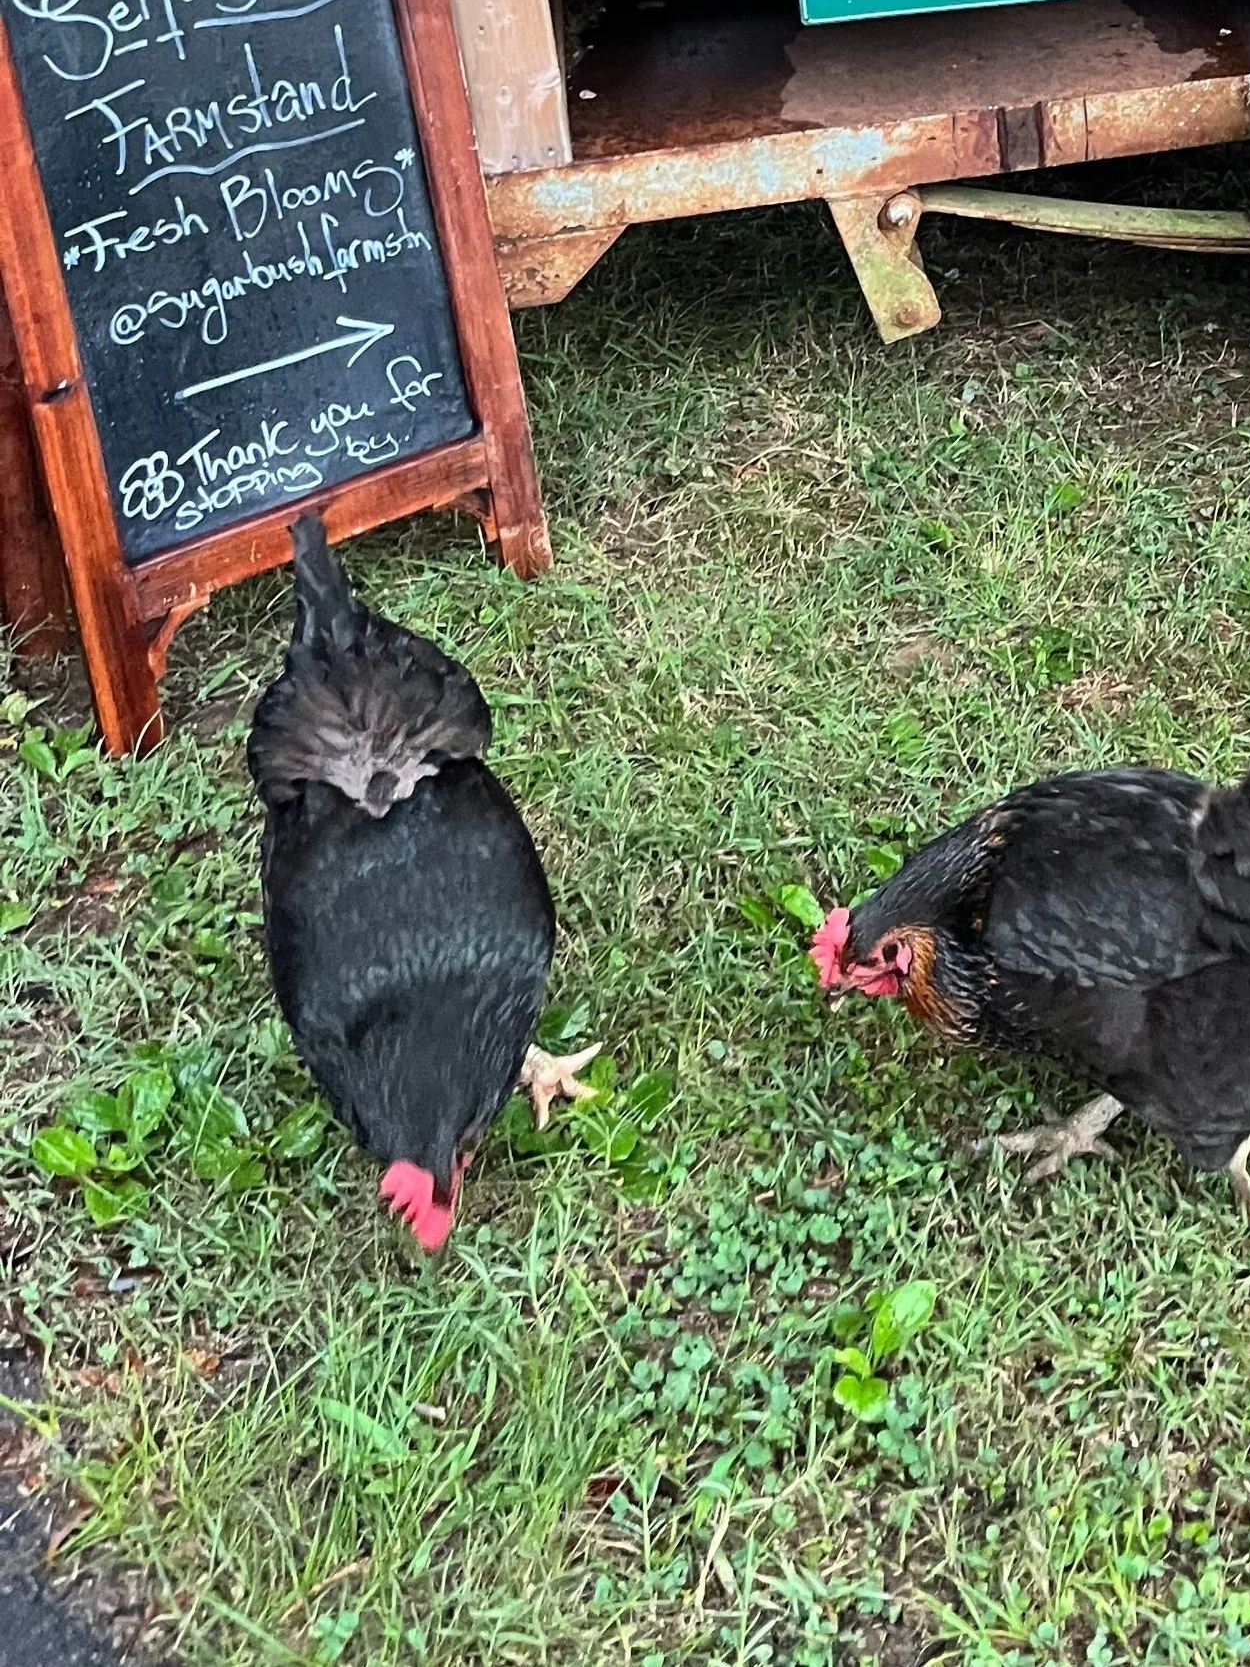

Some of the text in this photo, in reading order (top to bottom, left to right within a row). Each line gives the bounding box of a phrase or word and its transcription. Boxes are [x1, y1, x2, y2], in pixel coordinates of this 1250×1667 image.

[64, 196, 208, 272] Fresh
[176, 355, 442, 486] Thank you for
[174, 461, 322, 530] stopping
